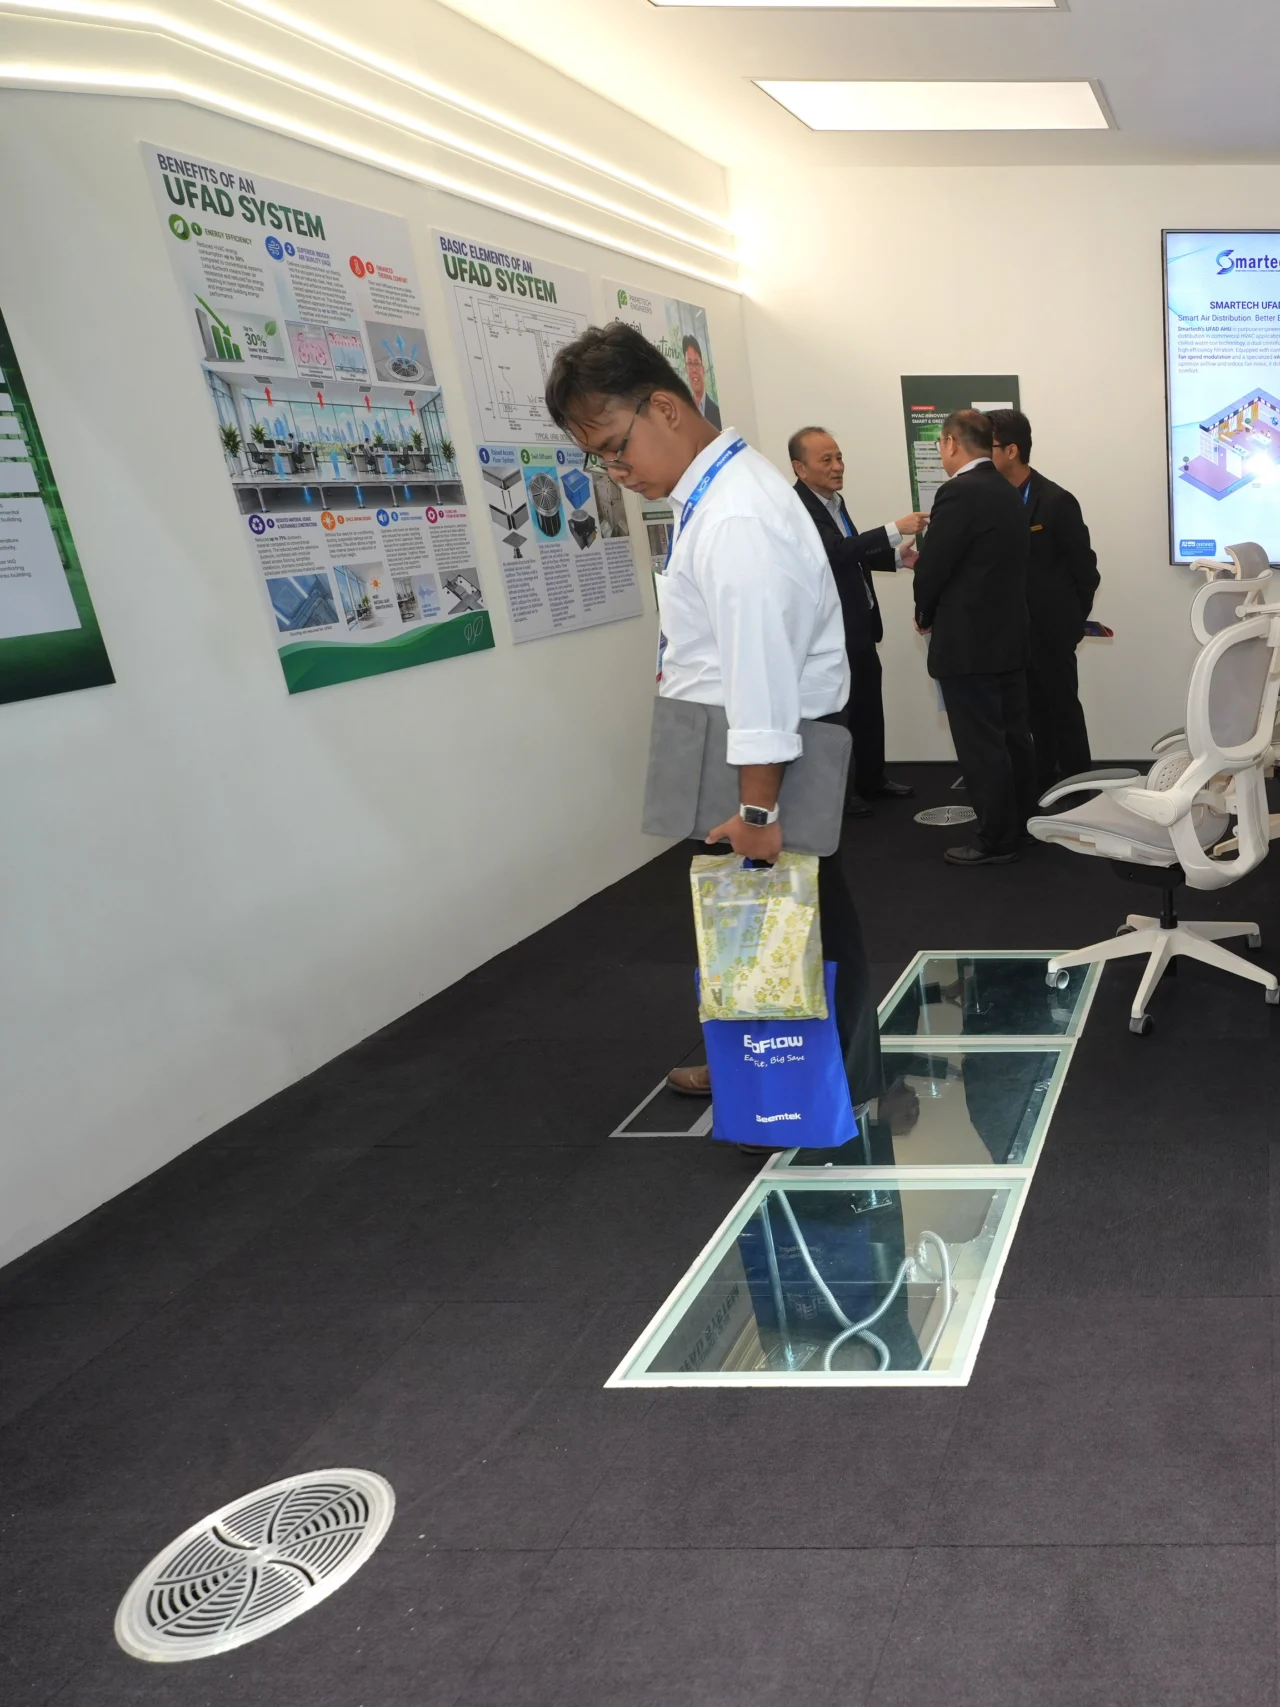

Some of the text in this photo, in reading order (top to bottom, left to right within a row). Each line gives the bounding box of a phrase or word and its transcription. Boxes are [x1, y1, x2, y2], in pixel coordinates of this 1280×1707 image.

[157, 153, 256, 195] BENEFITS OF AN
[162, 174, 326, 241] UFAD SYSTEM
[440, 237, 533, 274] BASIC ELEMENTS OF AN
[443, 253, 558, 304] UFAD SYSTEM
[1210, 301, 1259, 310] SMARTECH
[1178, 314, 1199, 322] Smart
[1200, 314, 1210, 322] Air
[1212, 314, 1253, 322] Distribution.
[1255, 314, 1275, 322] Better
[245, 333, 266, 347] 30%
[482, 452, 486, 461] 1
[770, 1055, 785, 1065] Big
[787, 1054, 805, 1062] Save
[756, 1112, 802, 1123] Seemtek
